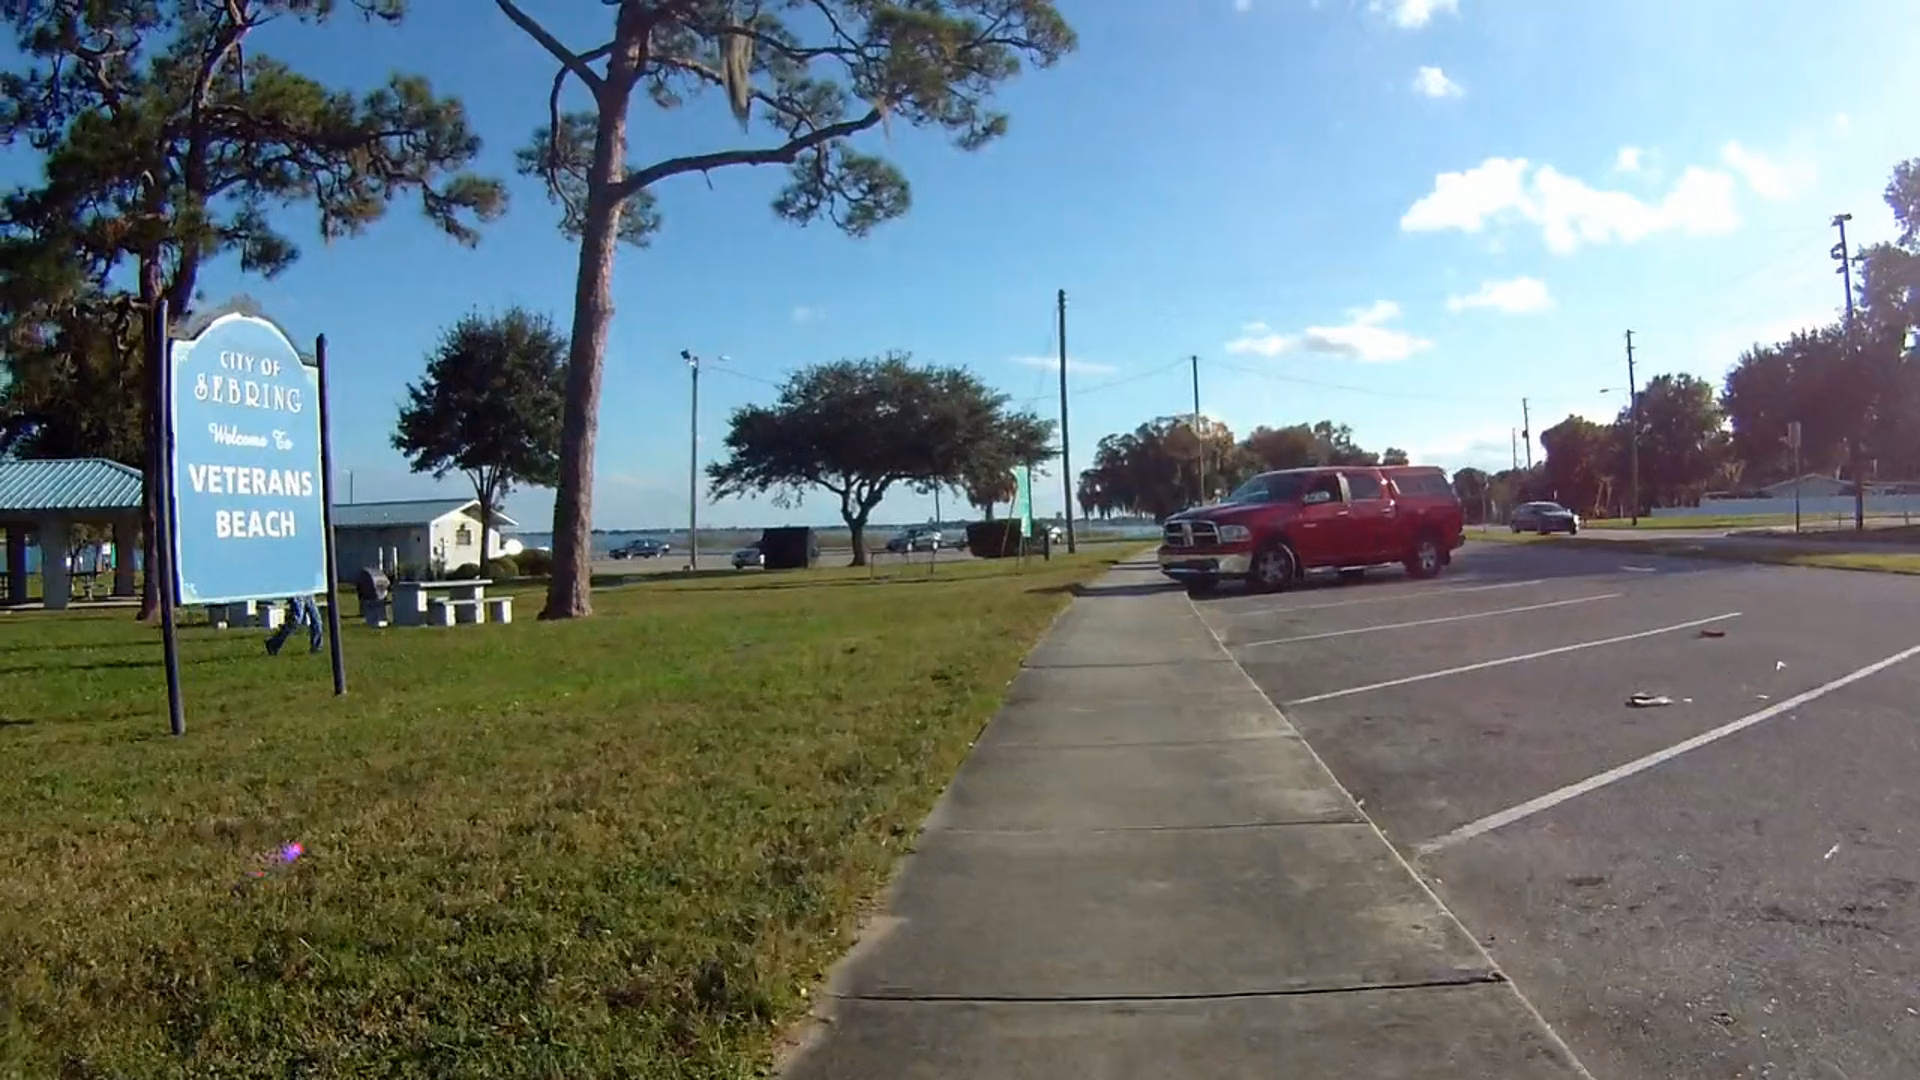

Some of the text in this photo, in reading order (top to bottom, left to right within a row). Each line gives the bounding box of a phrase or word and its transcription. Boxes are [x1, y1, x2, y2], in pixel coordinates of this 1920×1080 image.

[220, 351, 281, 376] CITY OF
[194, 373, 302, 414] SEBRING
[208, 422, 294, 451] Welcome To
[188, 463, 313, 497] VETERANS
[215, 510, 296, 539] BEACH
